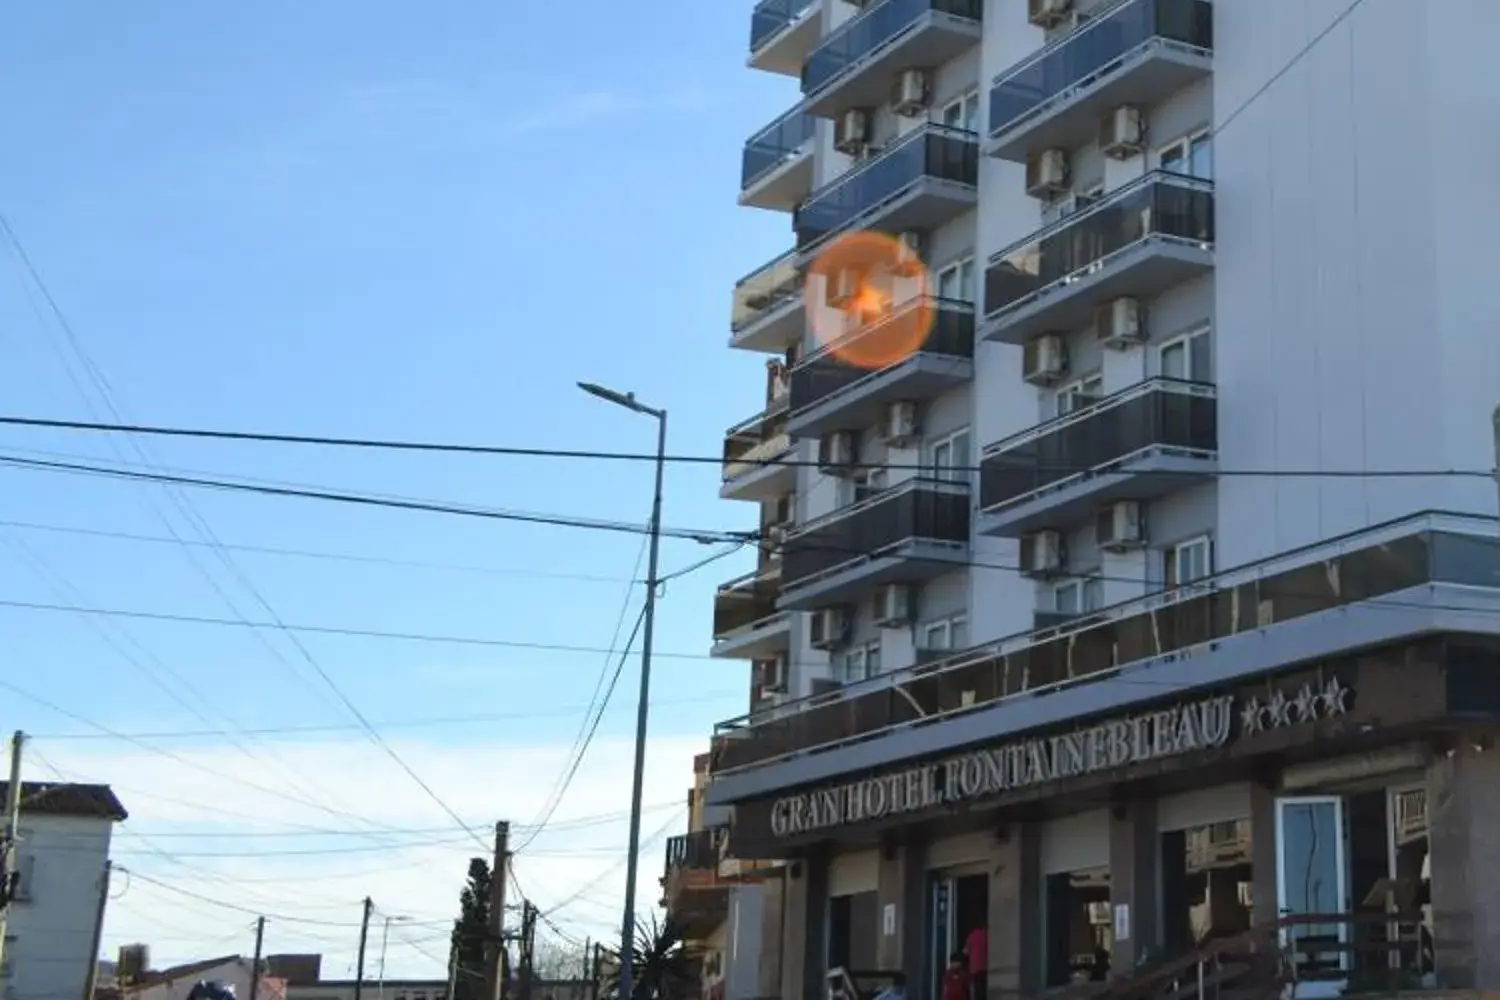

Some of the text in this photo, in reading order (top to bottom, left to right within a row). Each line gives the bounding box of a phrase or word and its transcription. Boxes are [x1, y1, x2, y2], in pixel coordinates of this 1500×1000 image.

[771, 697, 1234, 837] GRAN HOTEL FONTAINEBLEAU
